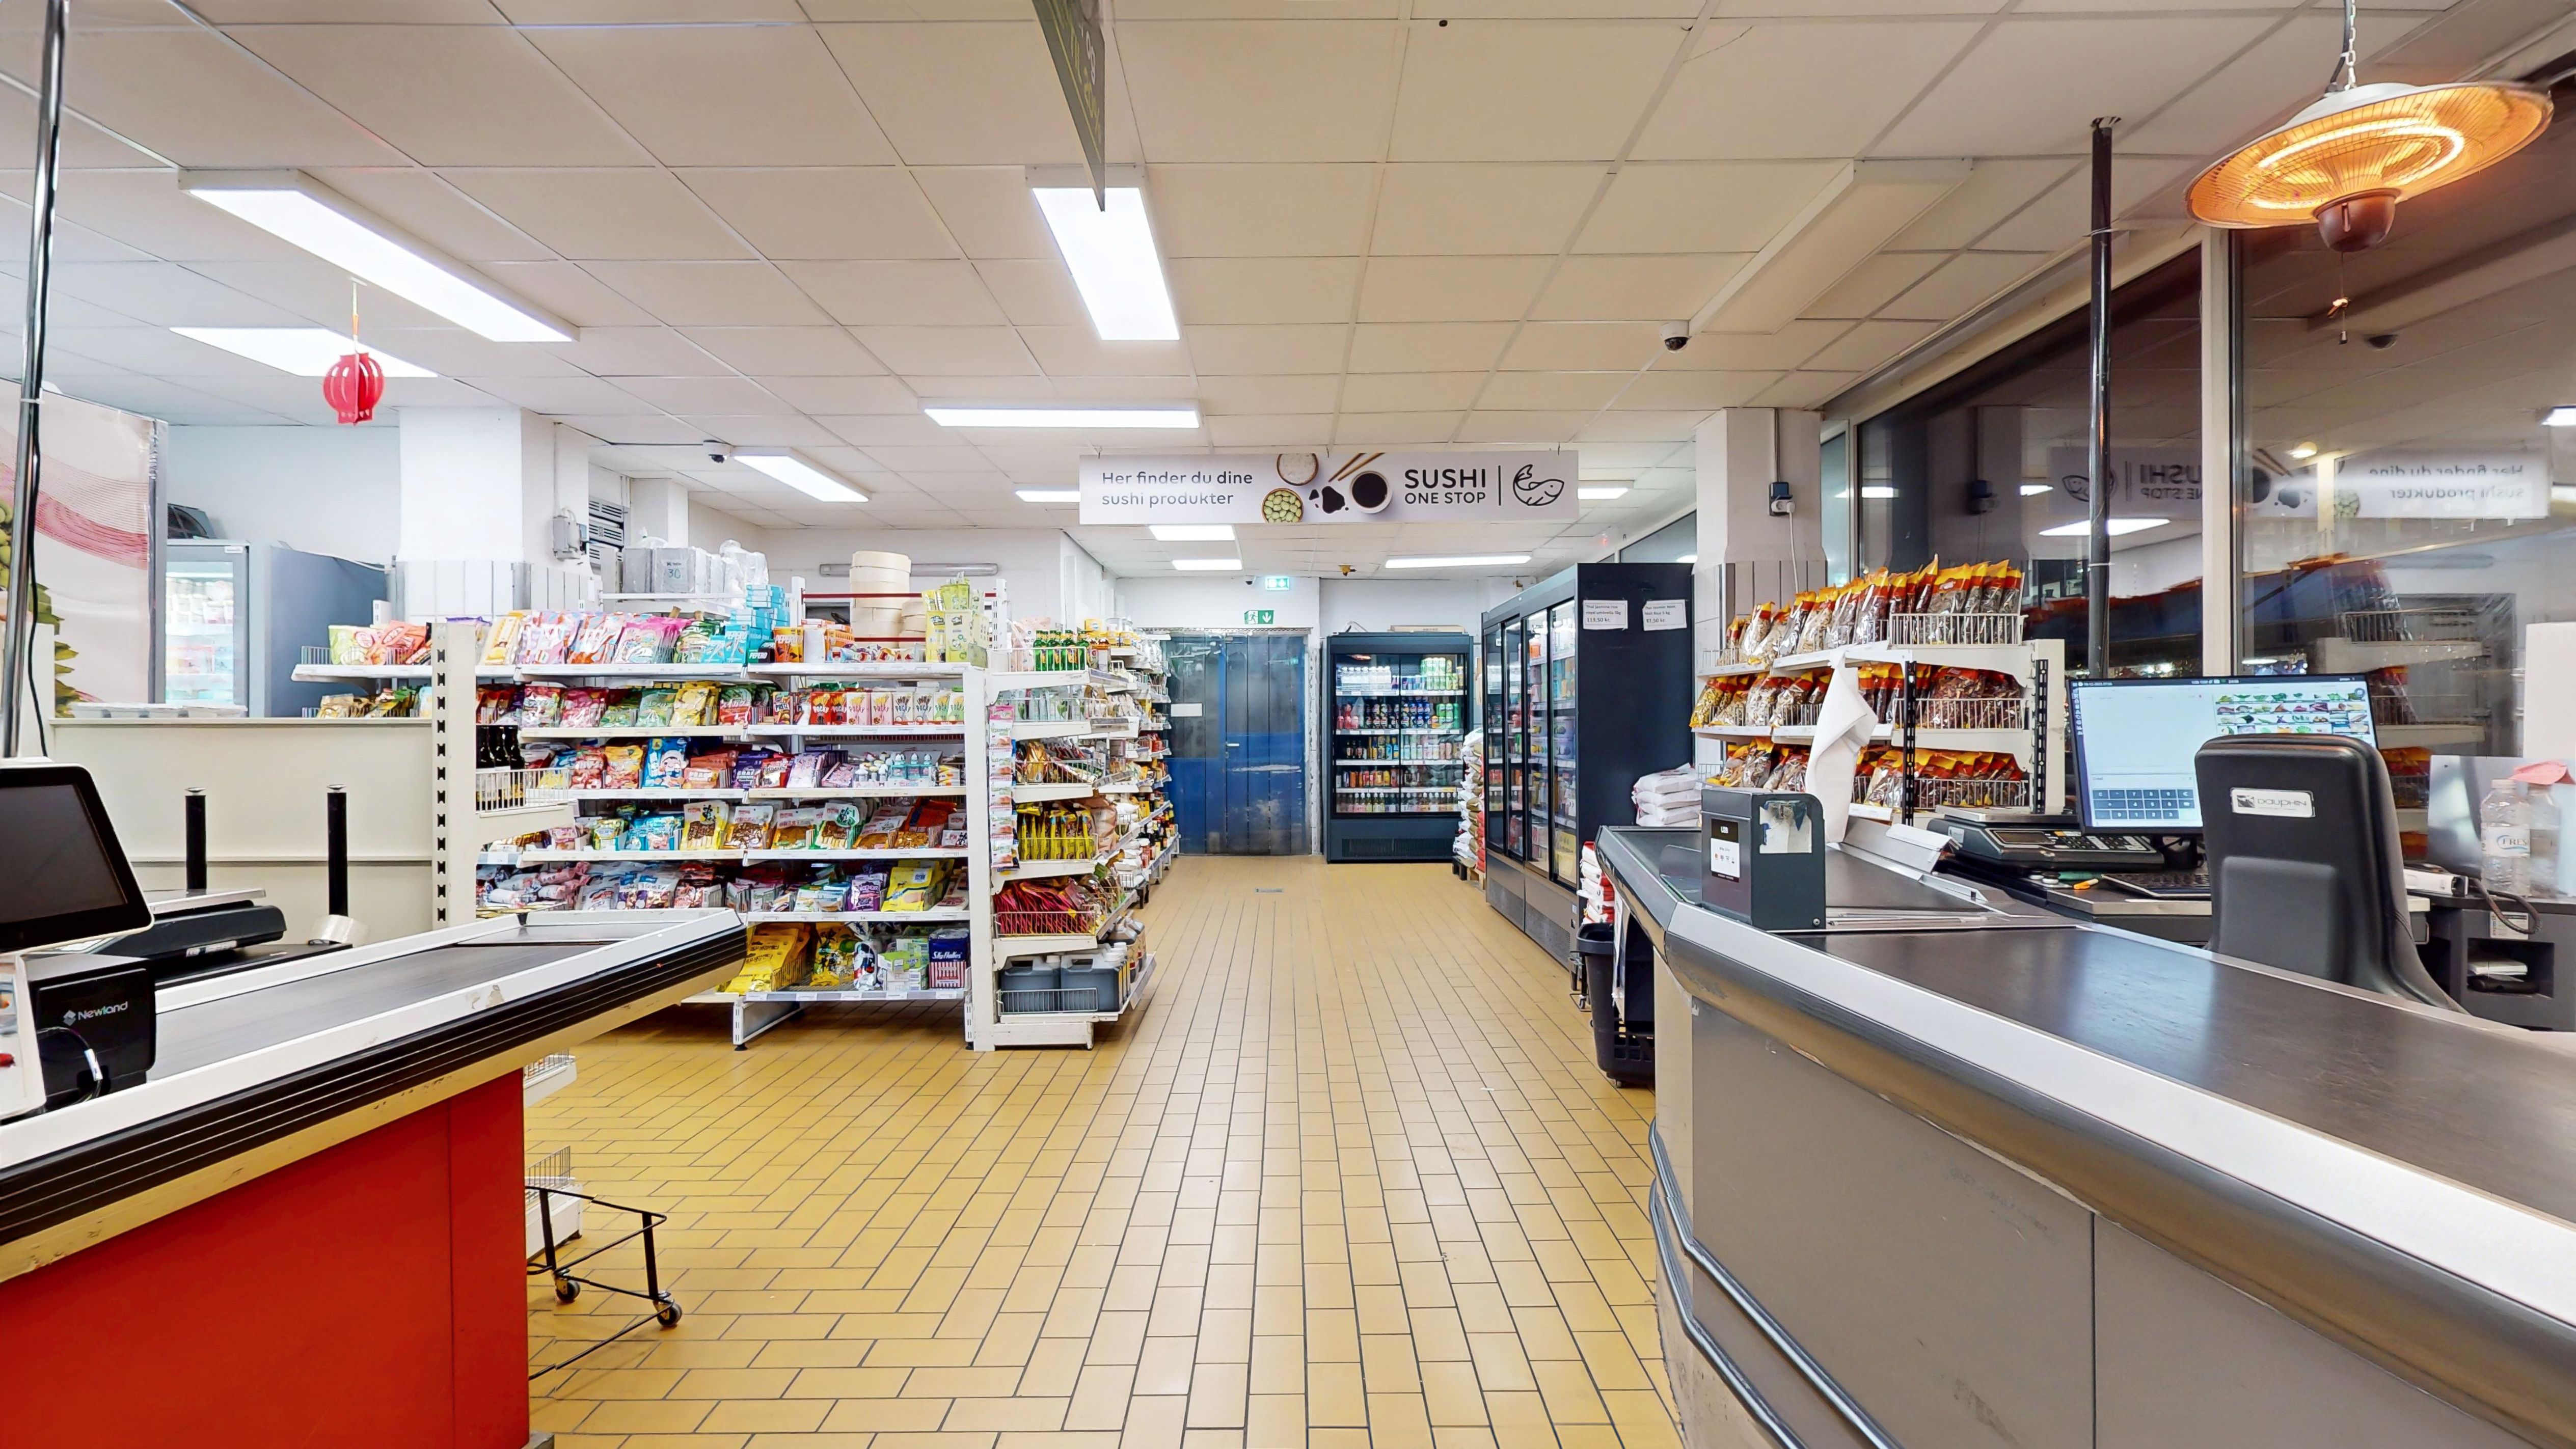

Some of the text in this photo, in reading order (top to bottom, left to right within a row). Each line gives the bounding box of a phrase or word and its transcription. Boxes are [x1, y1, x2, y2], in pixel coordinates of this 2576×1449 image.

[1102, 471, 1253, 484] Her finder du dine
[1404, 469, 1486, 489] SUSHI
[1102, 491, 1234, 508] sushi produkter
[1404, 491, 1486, 504] ONE STOP
[77, 1001, 128, 1020] Newland
